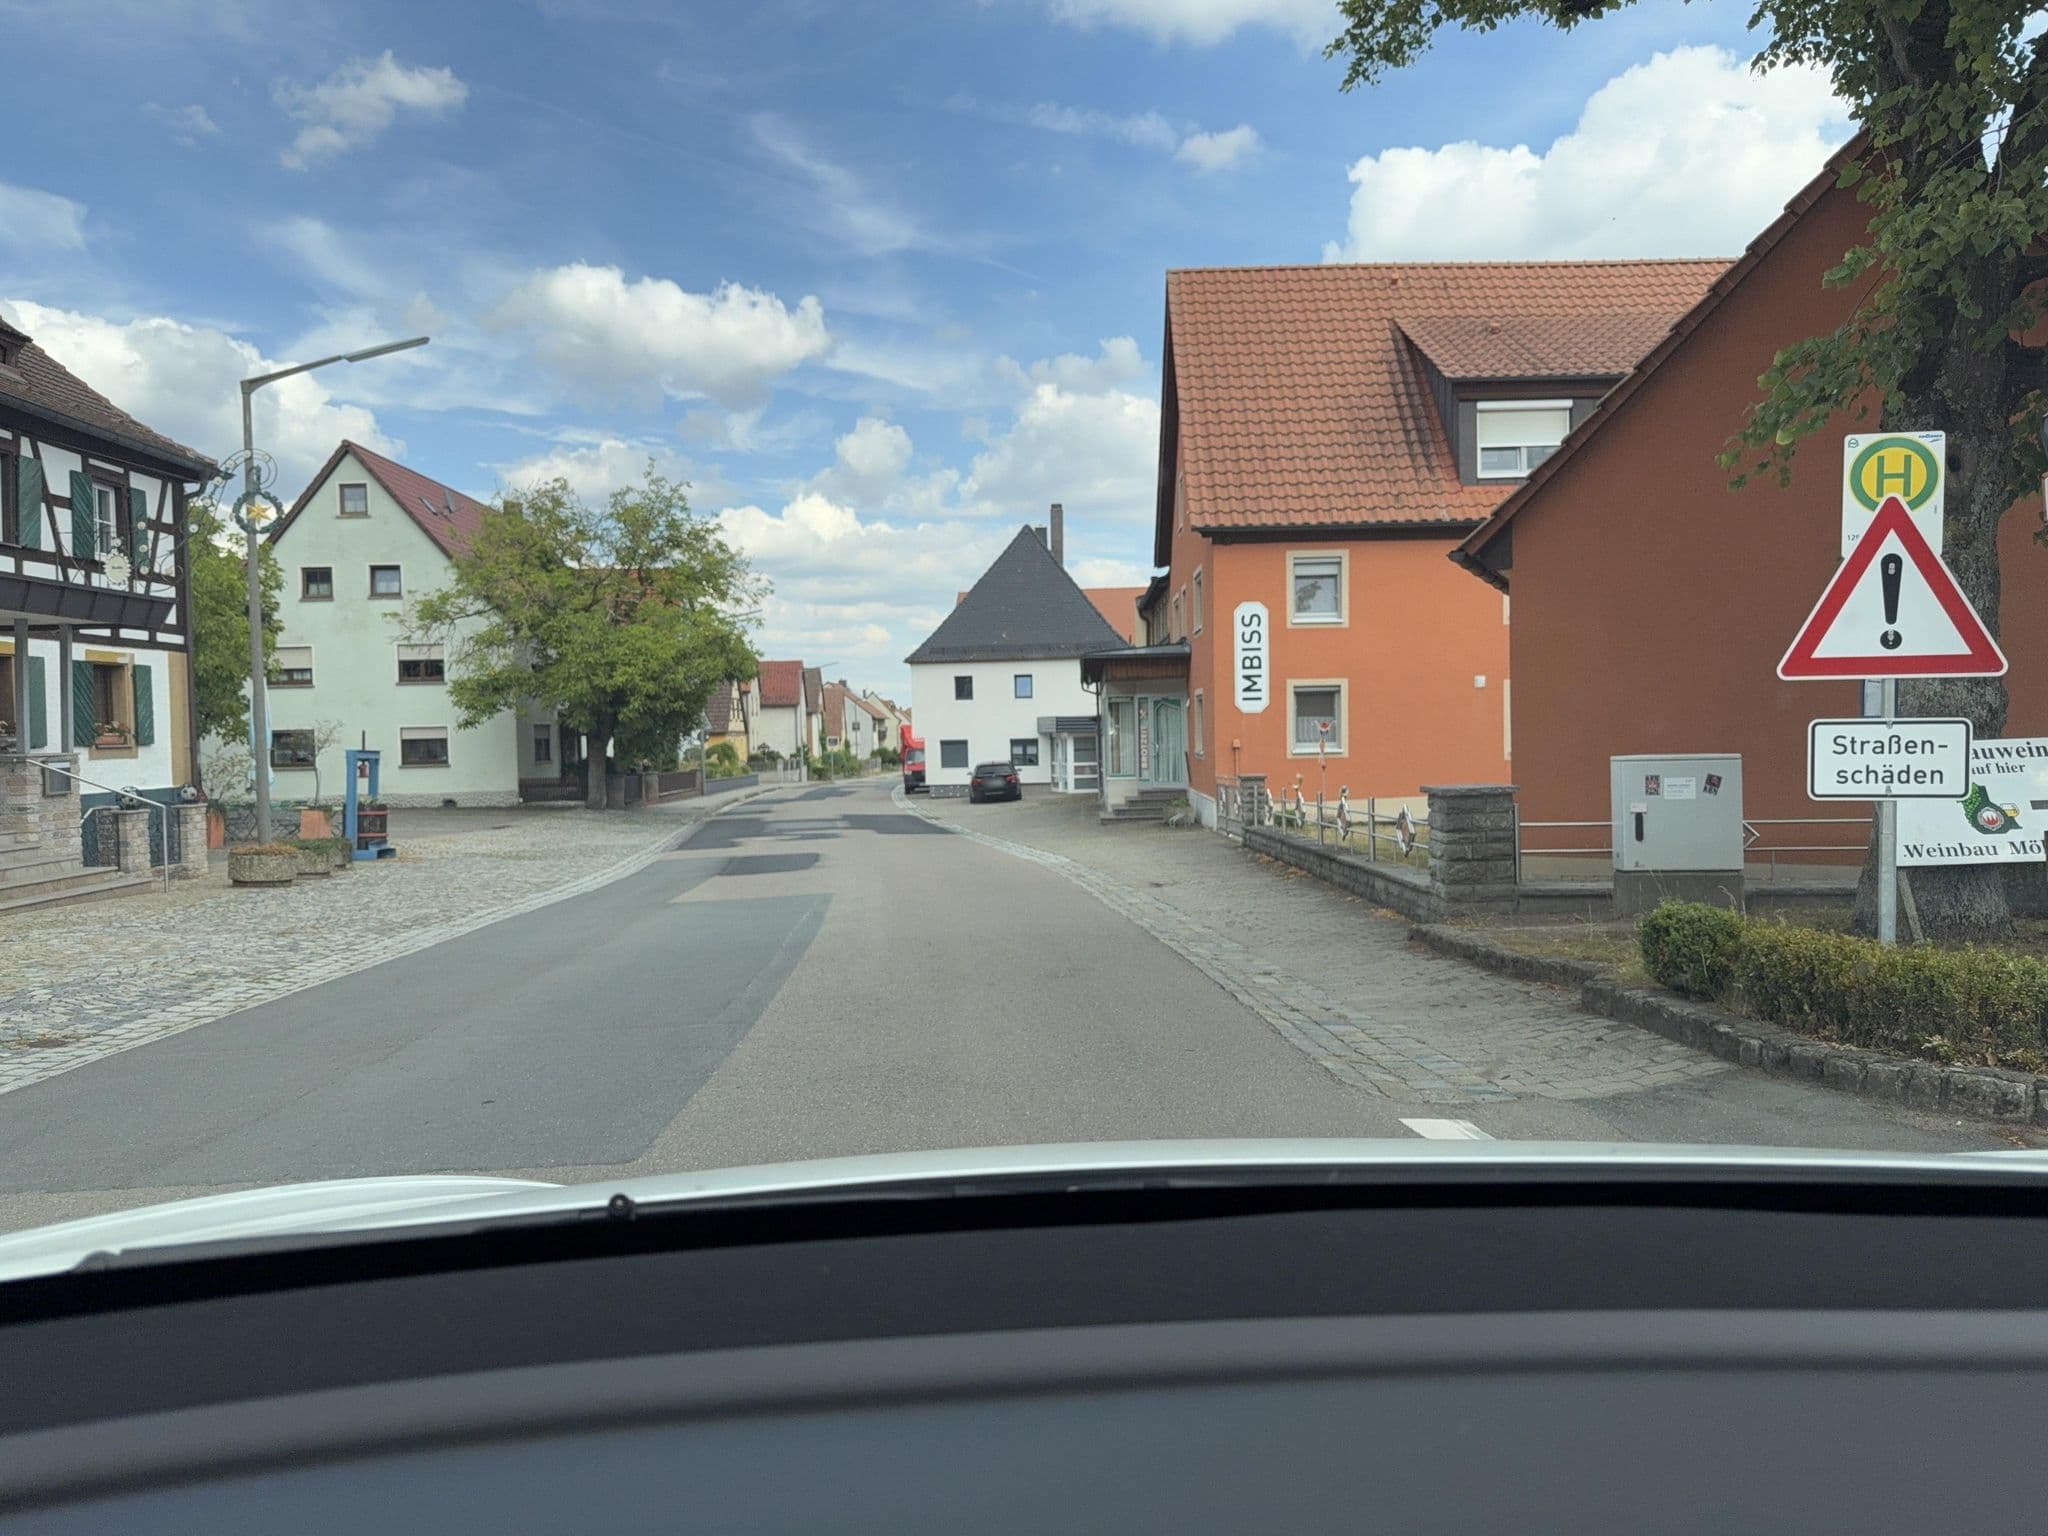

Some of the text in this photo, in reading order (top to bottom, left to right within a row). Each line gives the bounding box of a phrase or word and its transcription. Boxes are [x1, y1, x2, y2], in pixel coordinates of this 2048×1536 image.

[1876, 454, 1912, 498] H
[1241, 613, 1262, 701] IMBISS
[1832, 734, 1948, 755] Straßen-
[1971, 741, 2048, 760] auwein
[1836, 764, 1944, 785] schäden
[1995, 761, 2026, 774] hier
[1903, 842, 1999, 859] Weinbau
